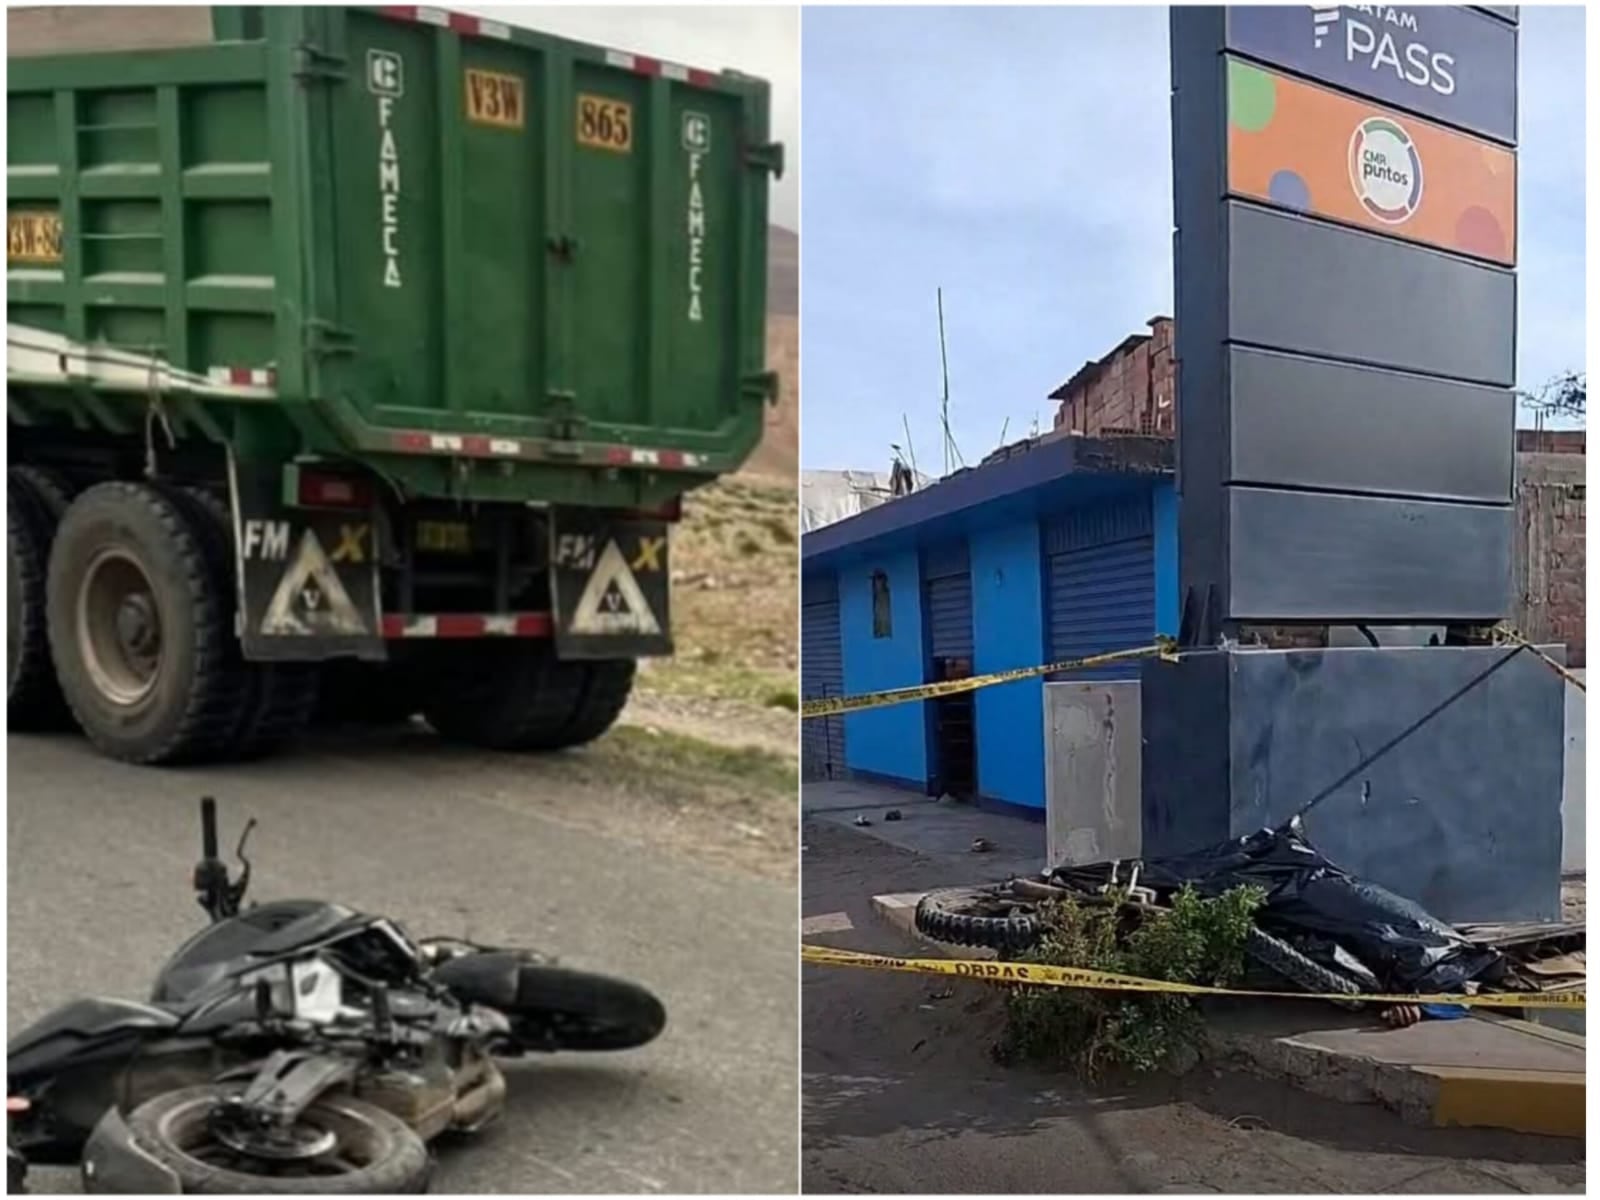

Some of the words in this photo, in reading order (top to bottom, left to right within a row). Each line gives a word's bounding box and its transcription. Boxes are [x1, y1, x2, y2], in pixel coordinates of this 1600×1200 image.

[1346, 18, 1455, 95] PASS
[469, 73, 519, 122] V3W
[580, 99, 629, 145] 865
[1363, 149, 1387, 165] CMR
[1363, 163, 1408, 186] puntos
[378, 97, 402, 288] FAMECA
[687, 153, 704, 322] FAMECA
[243, 519, 291, 560] FM
[331, 523, 369, 562] X
[633, 536, 666, 570] X
[954, 962, 1030, 979] OBRAS
